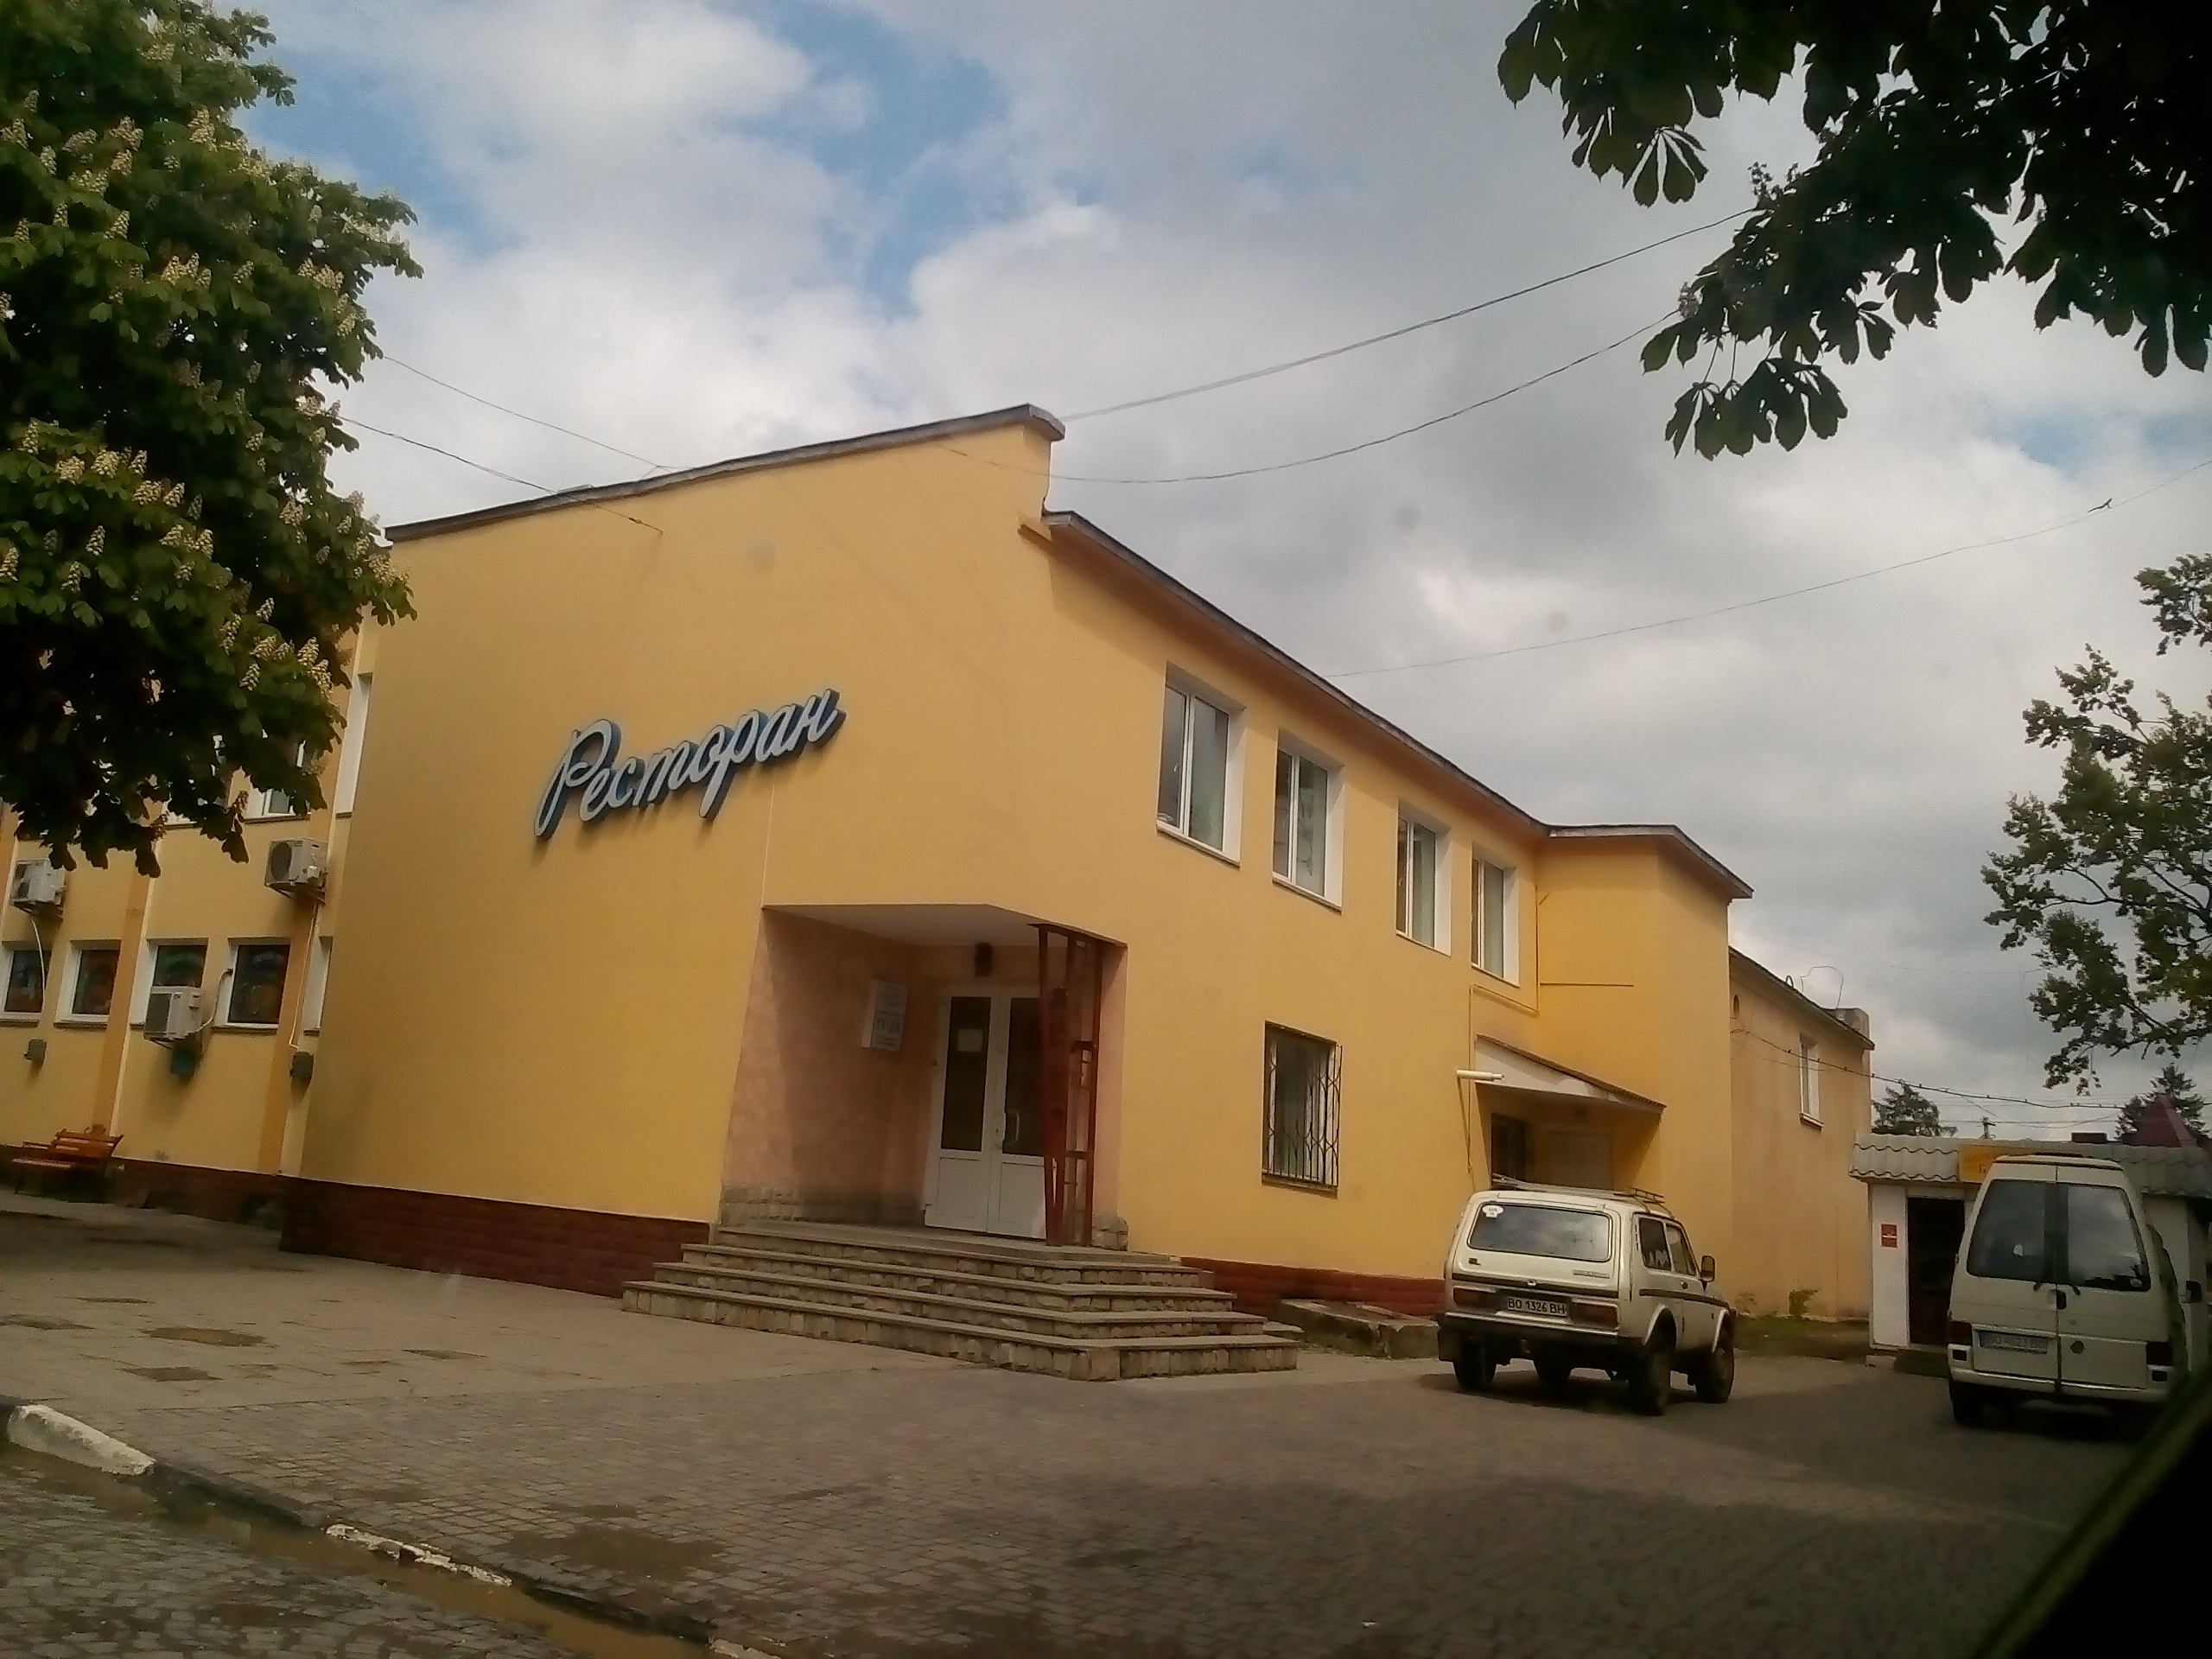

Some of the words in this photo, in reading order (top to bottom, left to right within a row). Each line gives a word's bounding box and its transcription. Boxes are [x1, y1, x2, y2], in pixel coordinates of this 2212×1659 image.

[534, 688, 847, 840] Ресторан
[1508, 1297, 1522, 1309] BO
[1525, 1300, 1548, 1313] 1326
[1549, 1303, 1565, 1314] BH
